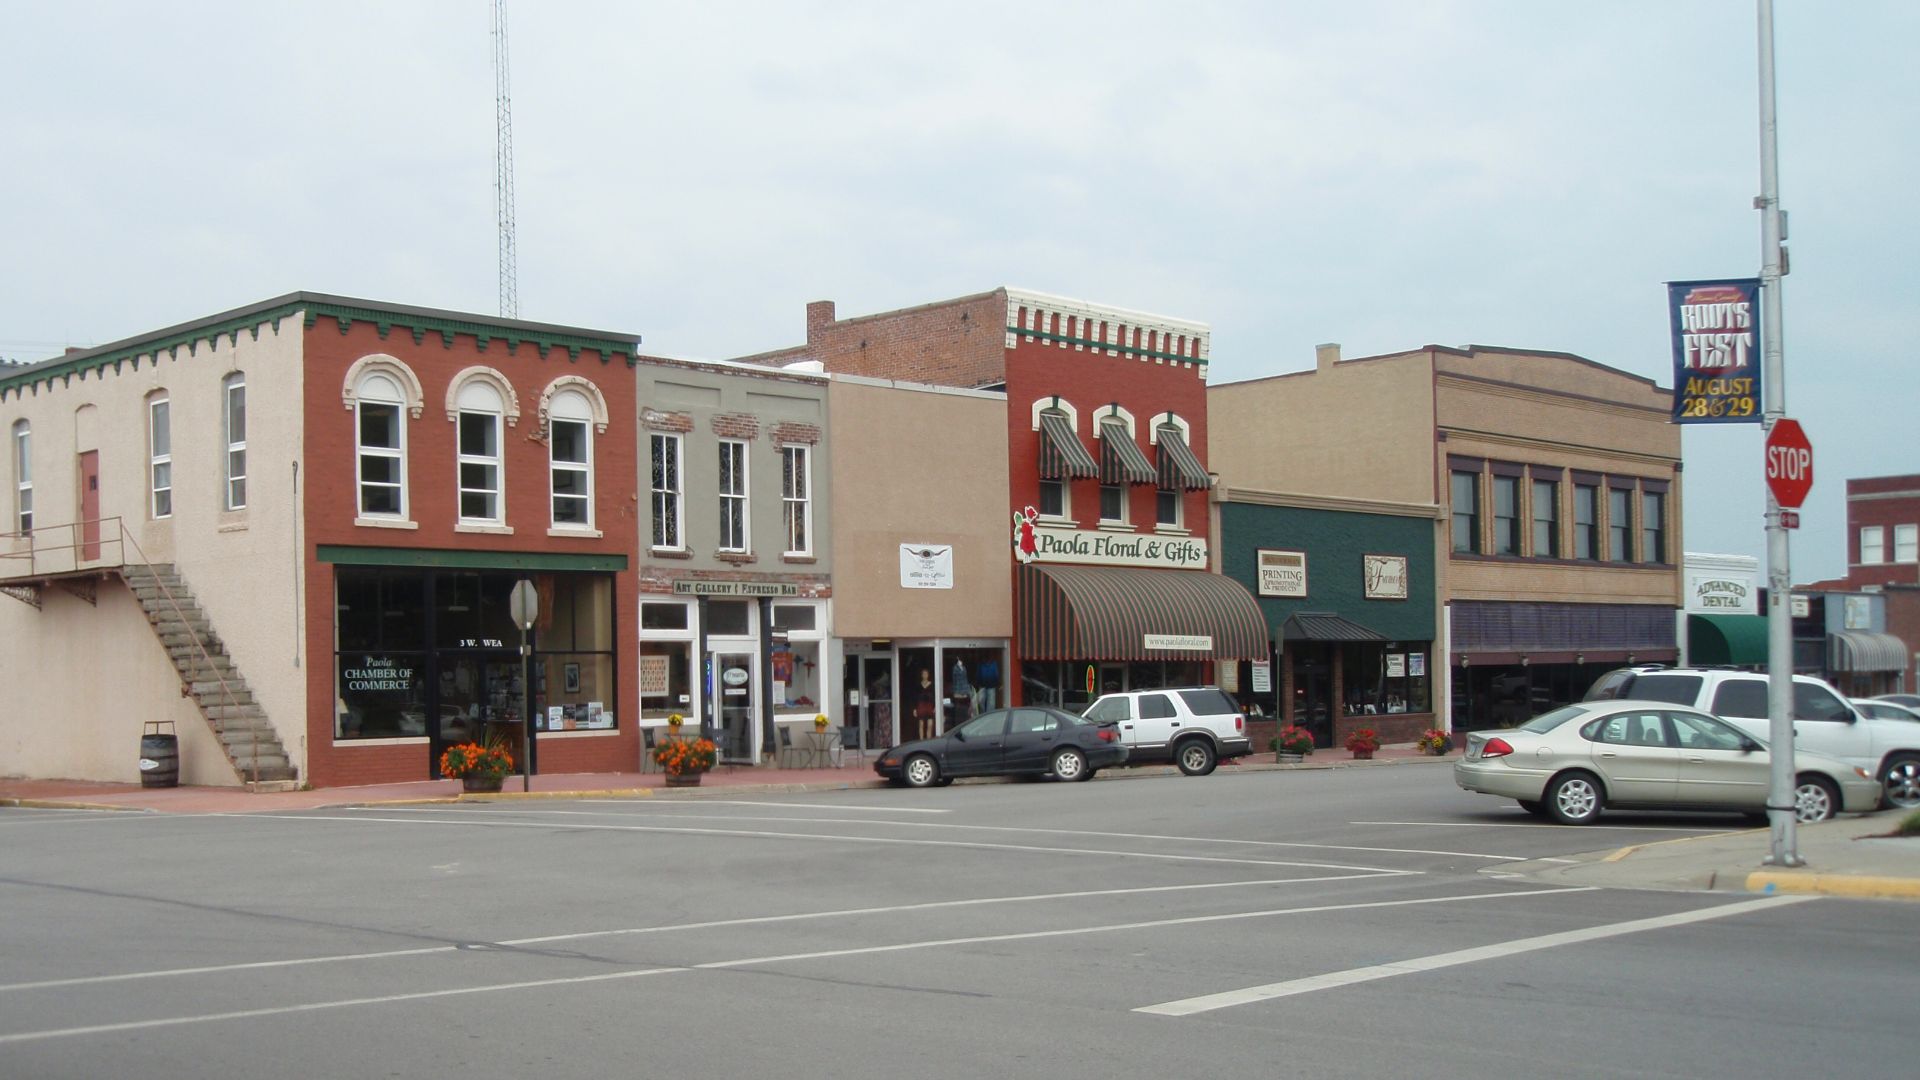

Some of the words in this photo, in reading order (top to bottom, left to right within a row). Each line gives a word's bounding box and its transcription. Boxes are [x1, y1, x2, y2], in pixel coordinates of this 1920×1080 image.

[1680, 303, 1750, 333] ROOTS
[1682, 333, 1752, 368] FEST
[1684, 377, 1752, 395] AUGUST
[1768, 446, 1810, 480] STOP
[1040, 533, 1089, 555] Paola
[1092, 536, 1142, 558] Floral
[1145, 541, 1161, 559] &
[1165, 541, 1200, 565] Gifts
[1262, 569, 1302, 581] PRINTING
[1696, 580, 1746, 597] ADVANCED
[1703, 596, 1741, 607] DENTAL
[483, 639, 502, 647] WEA
[366, 656, 393, 667] Paola
[344, 669, 397, 679] CHAMBER
[399, 669, 413, 678] OF
[349, 680, 410, 690] COMMERCE
